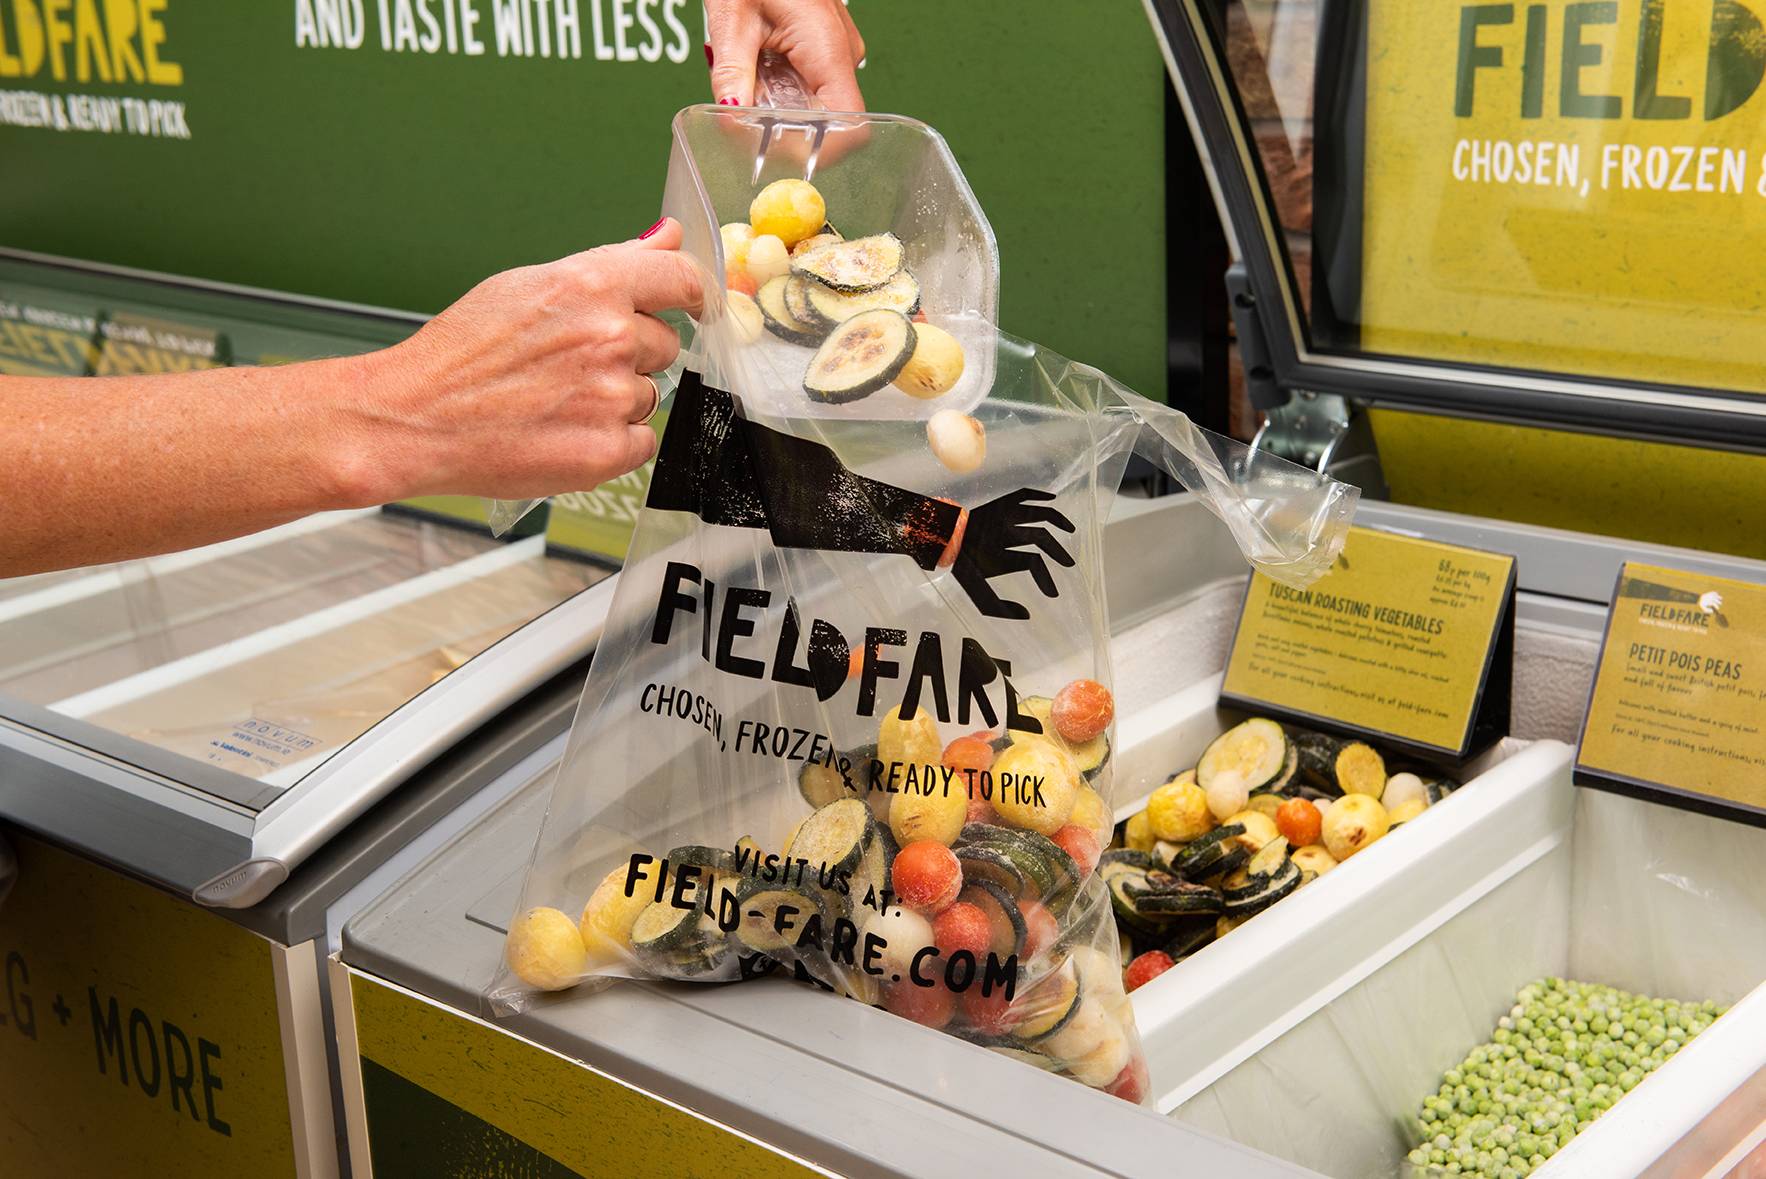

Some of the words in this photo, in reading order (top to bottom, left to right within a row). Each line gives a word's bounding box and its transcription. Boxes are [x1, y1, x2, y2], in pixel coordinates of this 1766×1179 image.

[295, 0, 366, 49] AND
[377, 0, 486, 55] TASTE
[493, 0, 583, 59] WITH
[590, 0, 690, 64] LESS
[1452, 138, 1590, 198] CHOSEN,
[1600, 143, 1748, 194] FROZEN
[1269, 582, 1313, 605] TUSCAN
[1315, 592, 1370, 619] ROASTING
[1373, 605, 1445, 635] VEGETABLES
[1640, 603, 1711, 628] FIELDFARE
[650, 561, 1044, 735] FIELDFARE
[1629, 643, 1667, 665] PETIT
[1668, 650, 1702, 672] POIS
[1704, 657, 1742, 680] PEAS
[1649, 668, 1663, 677] and
[244, 720, 315, 749] novum
[640, 683, 727, 753] CHOSEN,
[734, 719, 841, 774] FROZEN
[838, 757, 857, 792] &
[868, 759, 956, 800] READY
[963, 768, 994, 801] TO
[1000, 772, 1048, 809] PICK
[733, 844, 810, 884] VISIT
[818, 859, 852, 896] US
[861, 882, 903, 918] AT:
[623, 852, 1020, 1001] FIELD-FARE.COM
[0, 950, 37, 1042] G
[87, 984, 233, 1138] MORE
